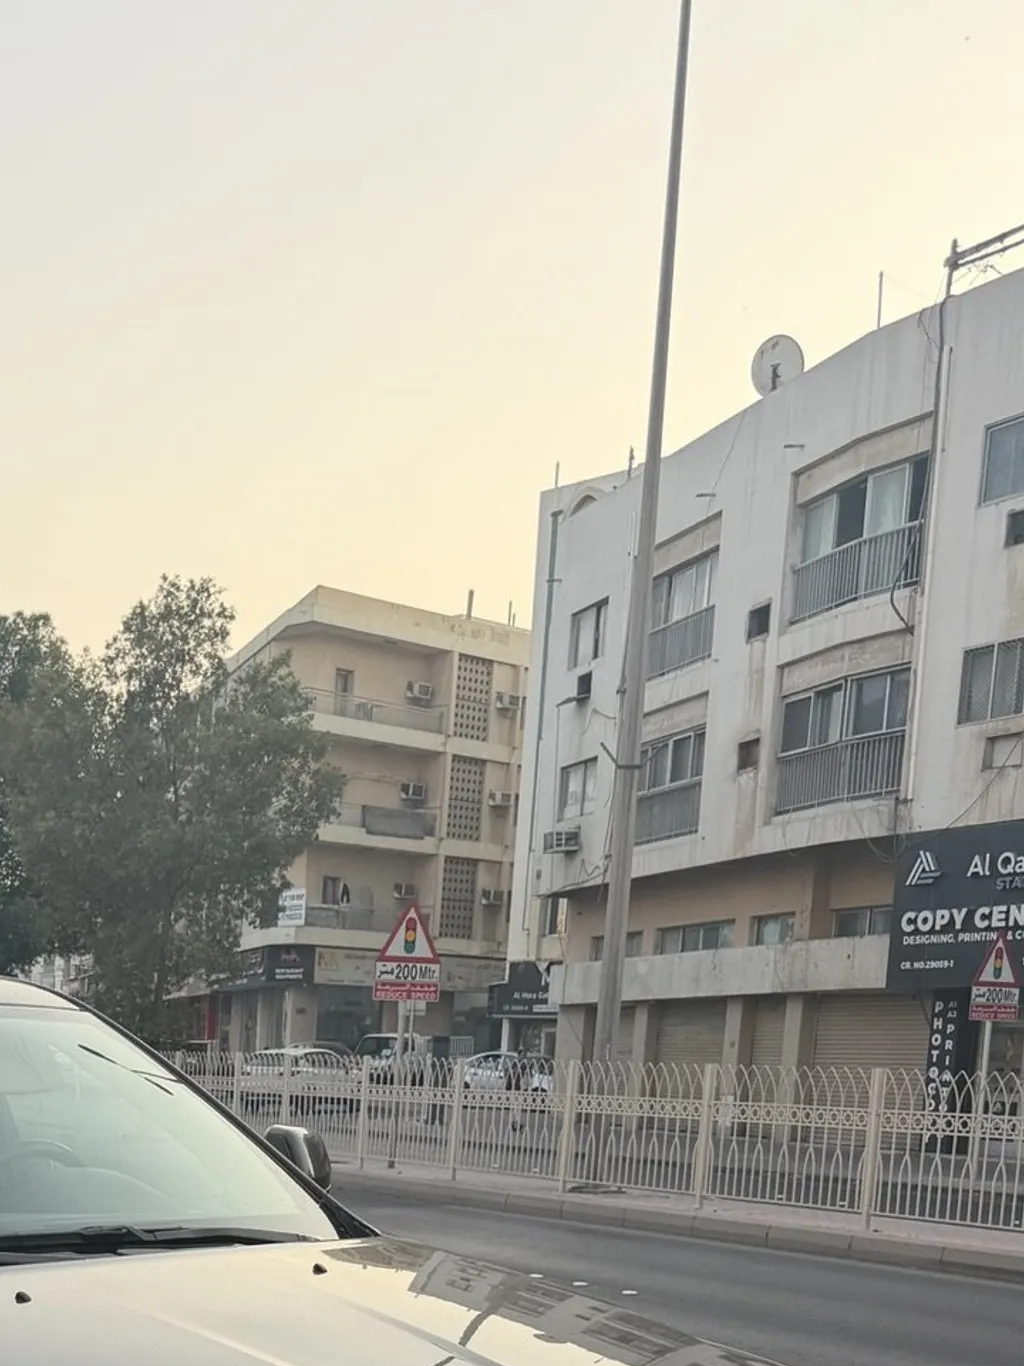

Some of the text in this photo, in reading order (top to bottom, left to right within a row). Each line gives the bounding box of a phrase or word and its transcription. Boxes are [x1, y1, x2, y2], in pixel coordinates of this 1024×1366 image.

[900, 907, 969, 933] COPY
[957, 930, 998, 943] PRINTIN
[377, 963, 395, 979] متر
[396, 963, 418, 980] 200
[419, 965, 439, 980] Mtr.
